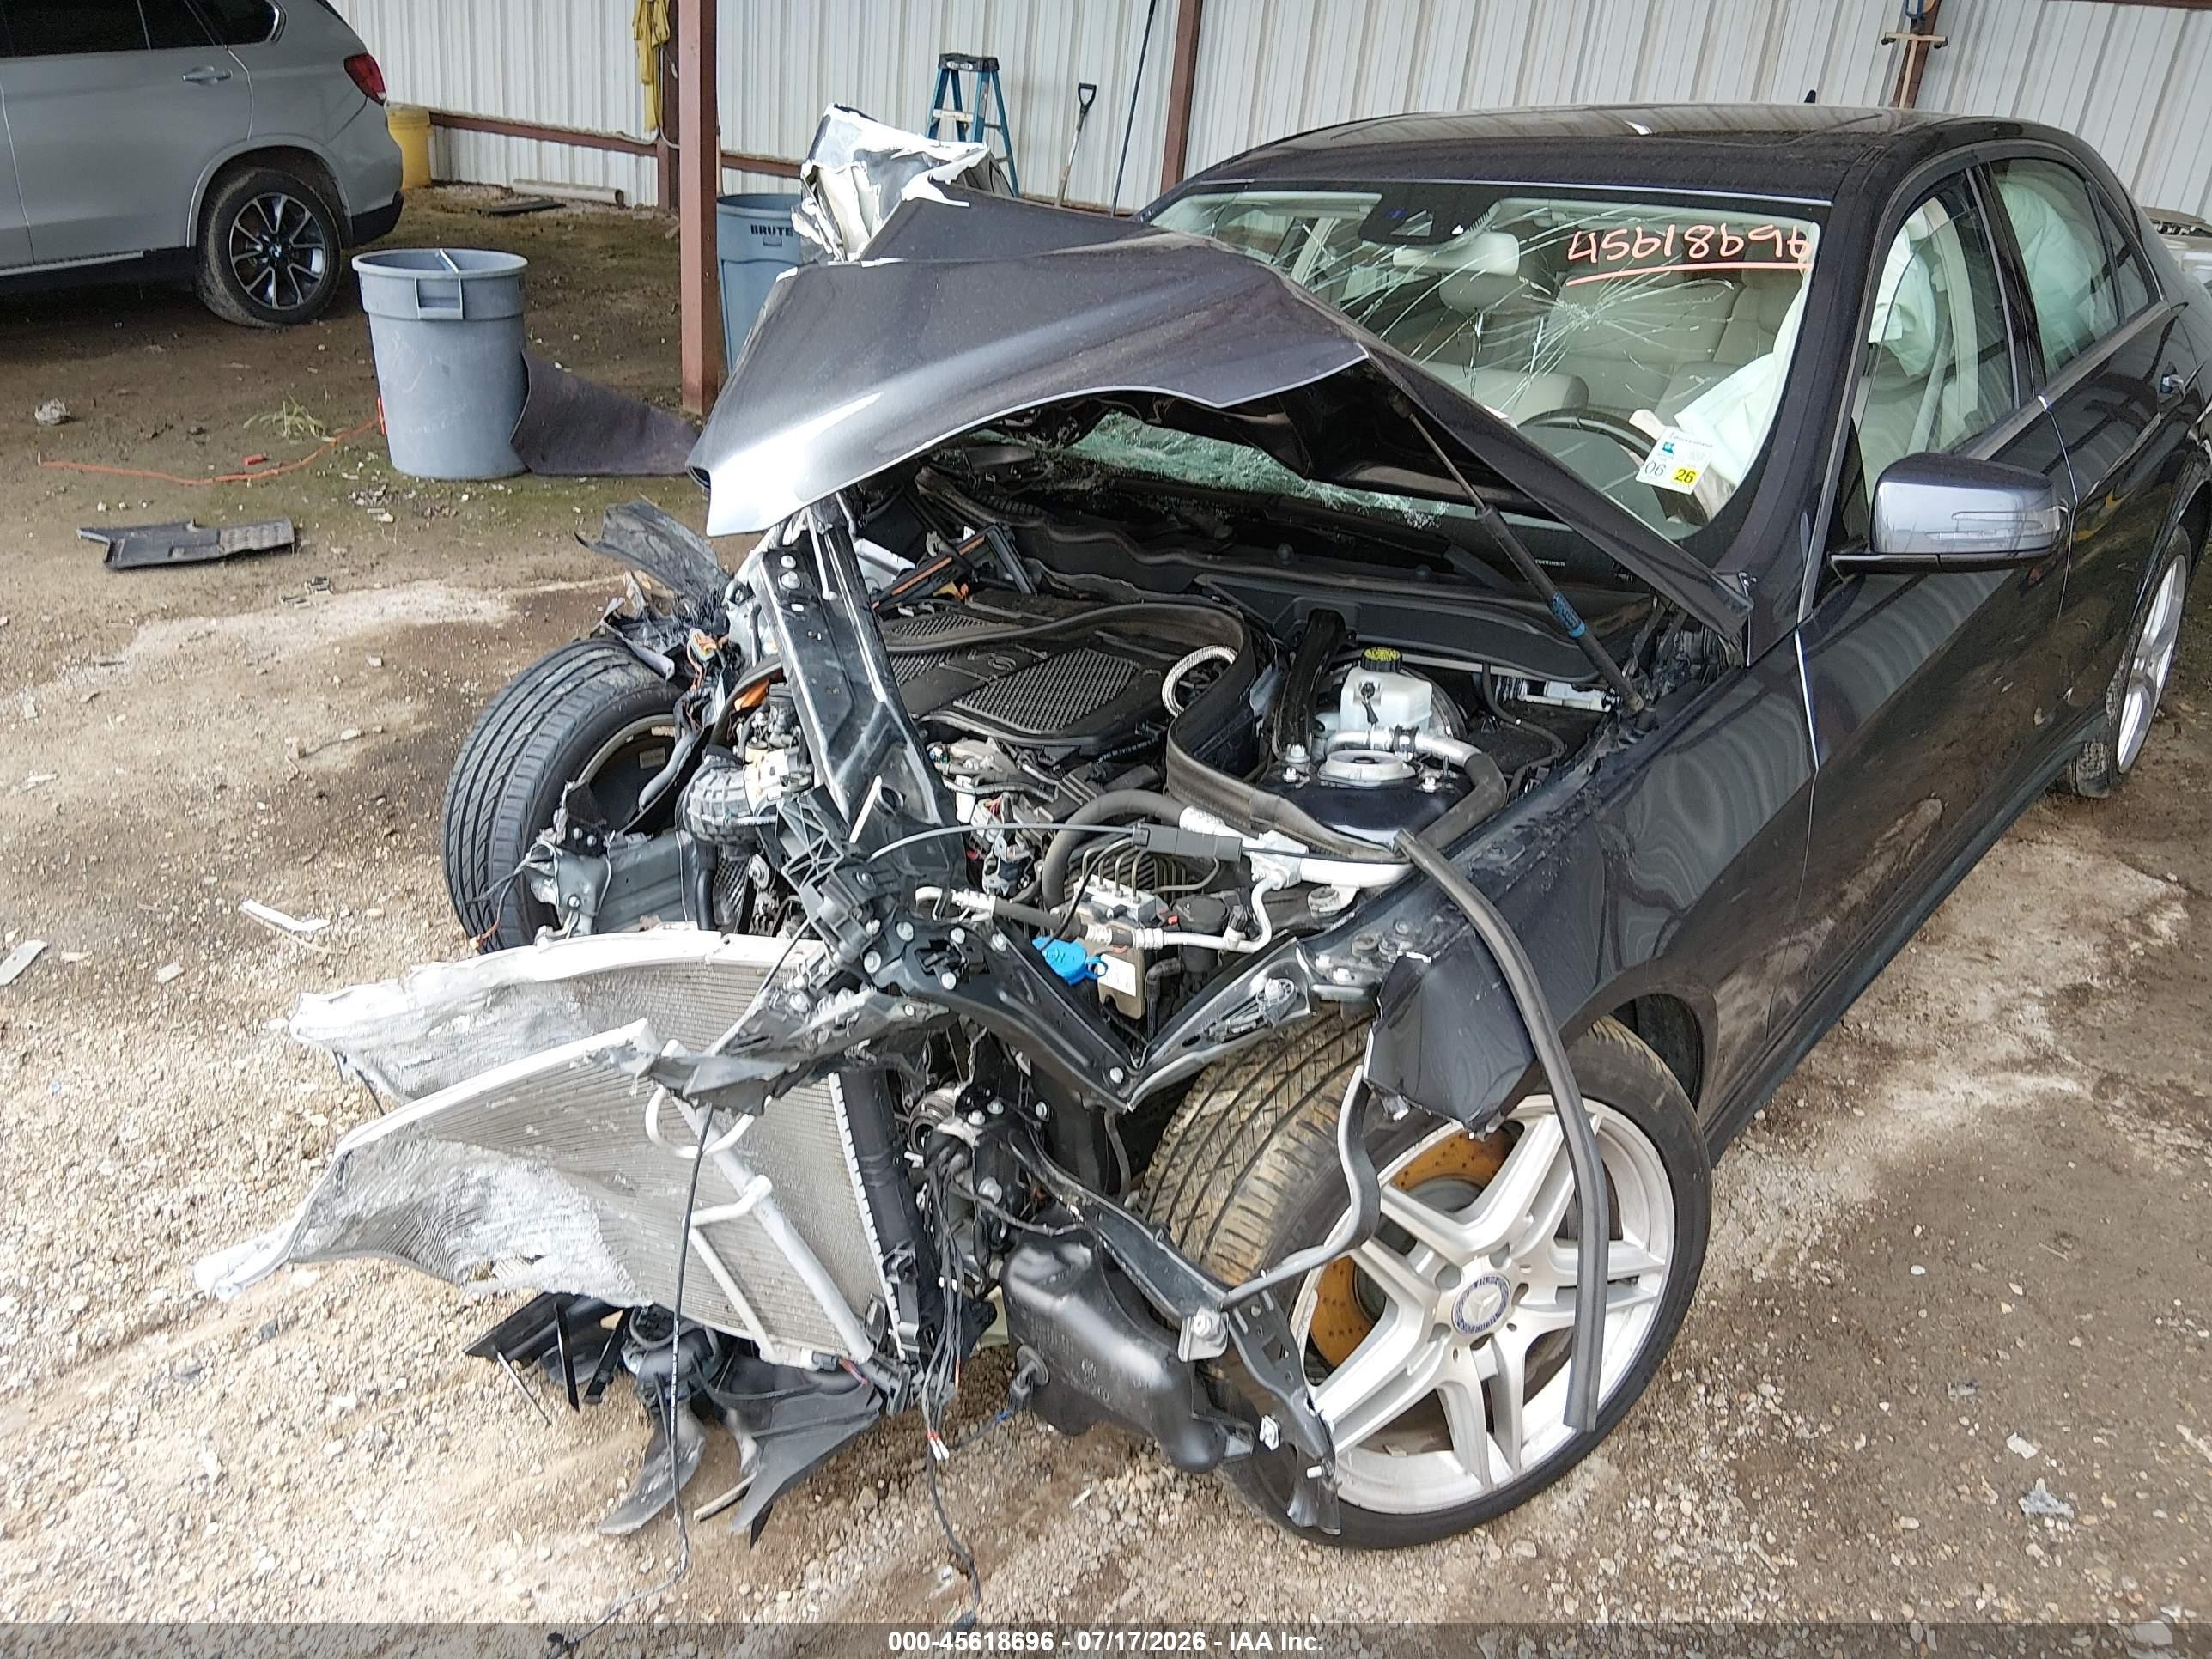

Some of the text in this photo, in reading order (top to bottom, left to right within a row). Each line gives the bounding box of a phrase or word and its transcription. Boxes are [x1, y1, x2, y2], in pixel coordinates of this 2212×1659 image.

[750, 224, 793, 237] BRUTE
[1644, 460, 1667, 477] 06
[1674, 467, 1697, 484] 26
